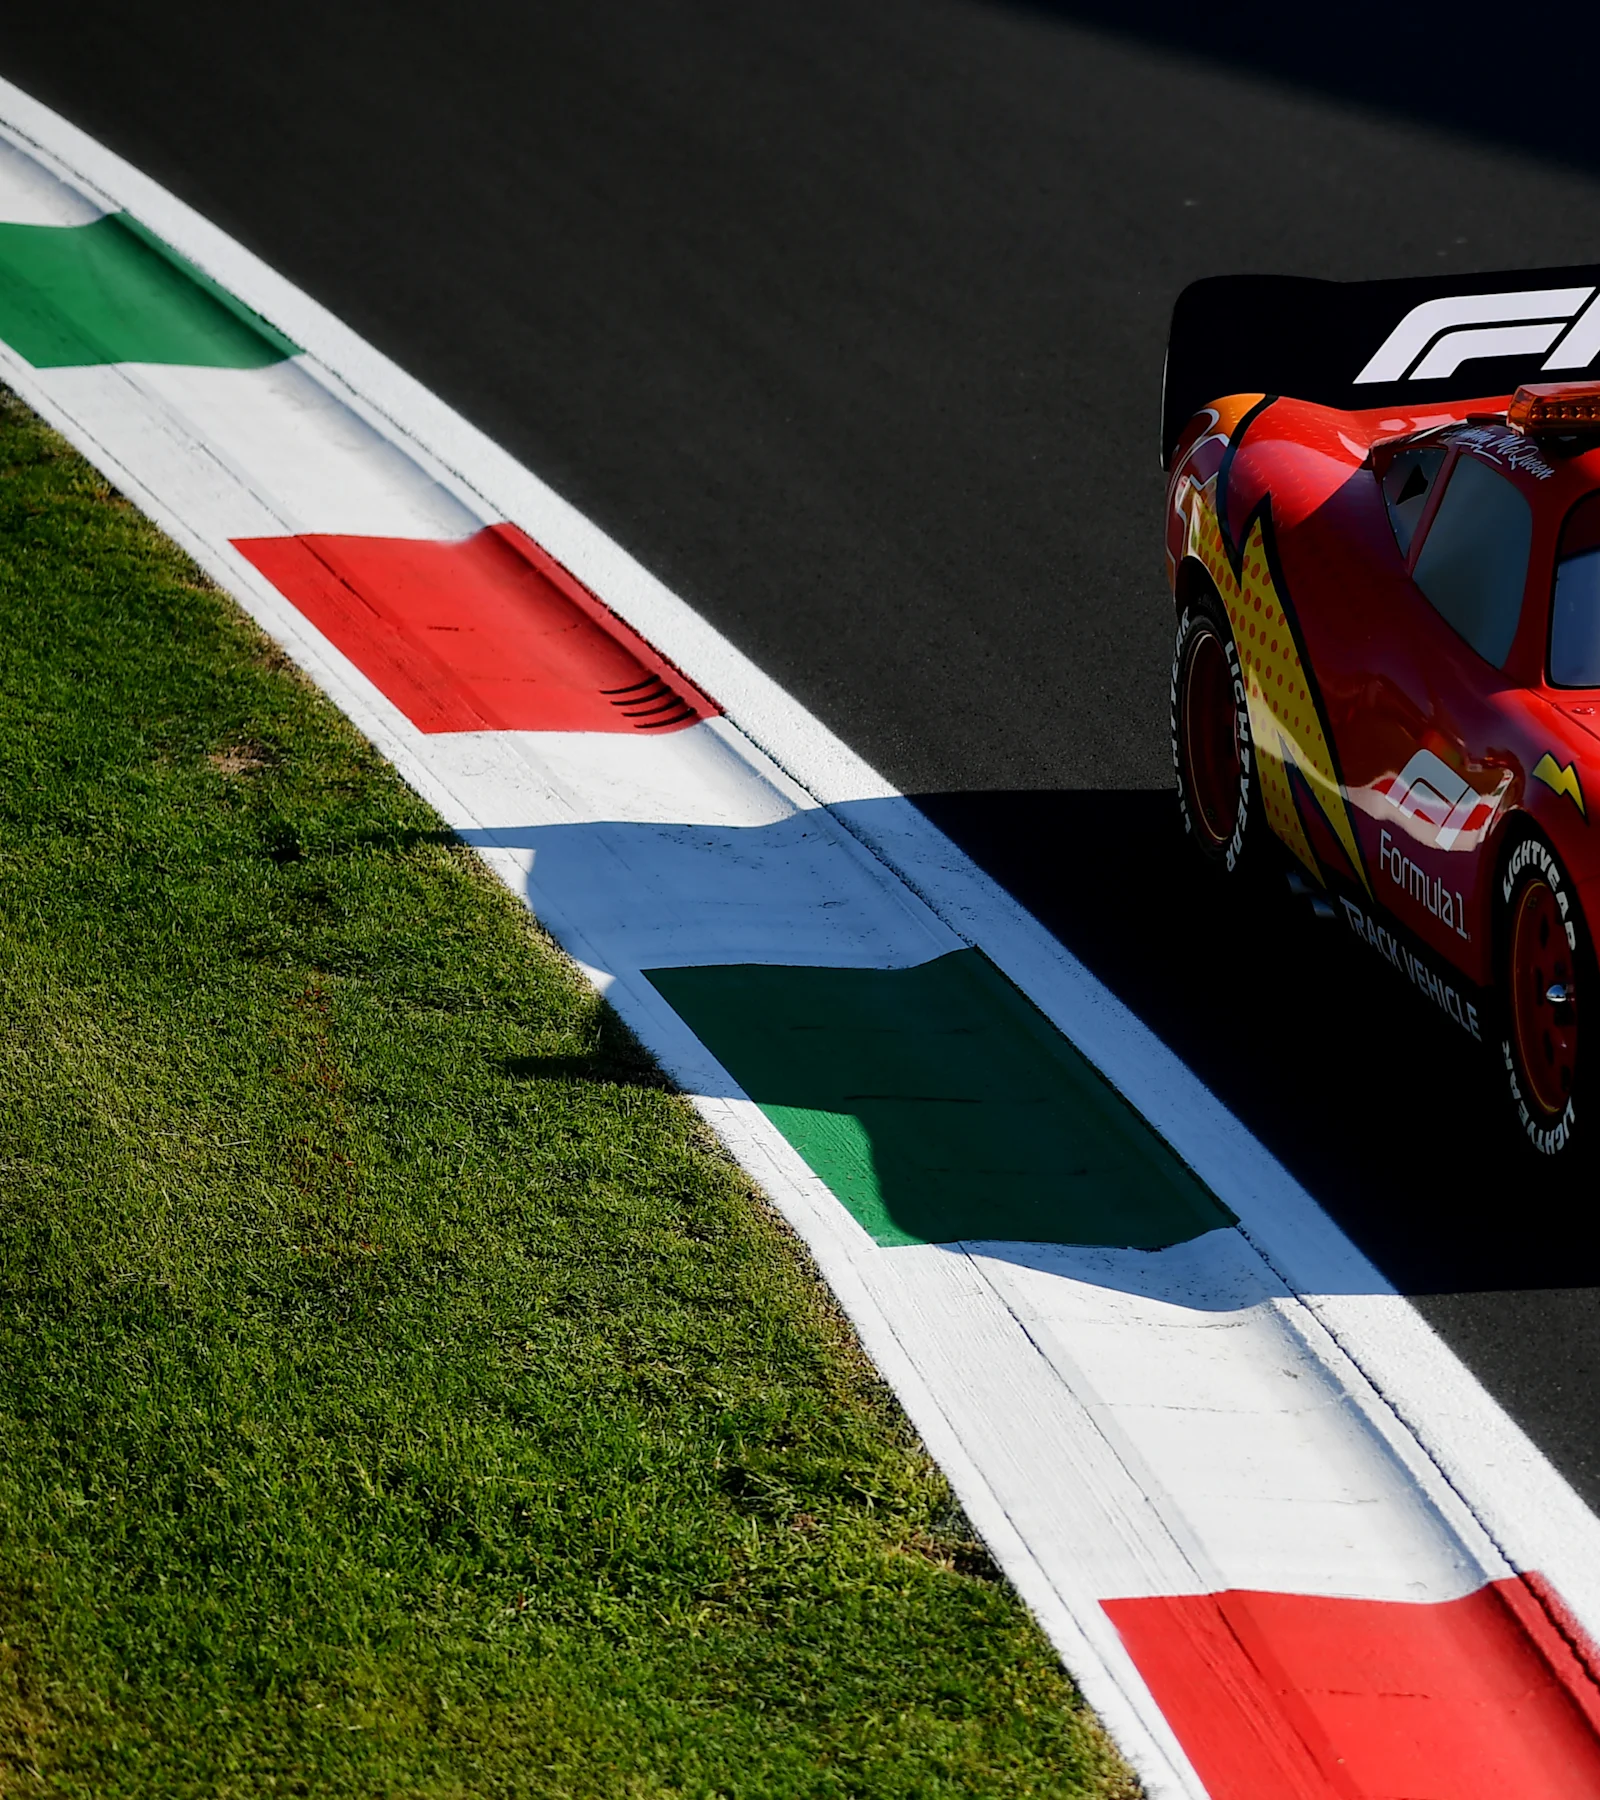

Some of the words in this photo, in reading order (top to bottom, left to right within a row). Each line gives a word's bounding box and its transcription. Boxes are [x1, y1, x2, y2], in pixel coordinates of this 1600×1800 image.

[1224, 639, 1251, 873] LIGHTYEAR
[1503, 839, 1577, 951] LIGHTYEAR
[1339, 894, 1403, 972] TRACK
[1401, 944, 1484, 1043] VEHICLE
[1501, 1039, 1576, 1156] LIGHTYEAR
